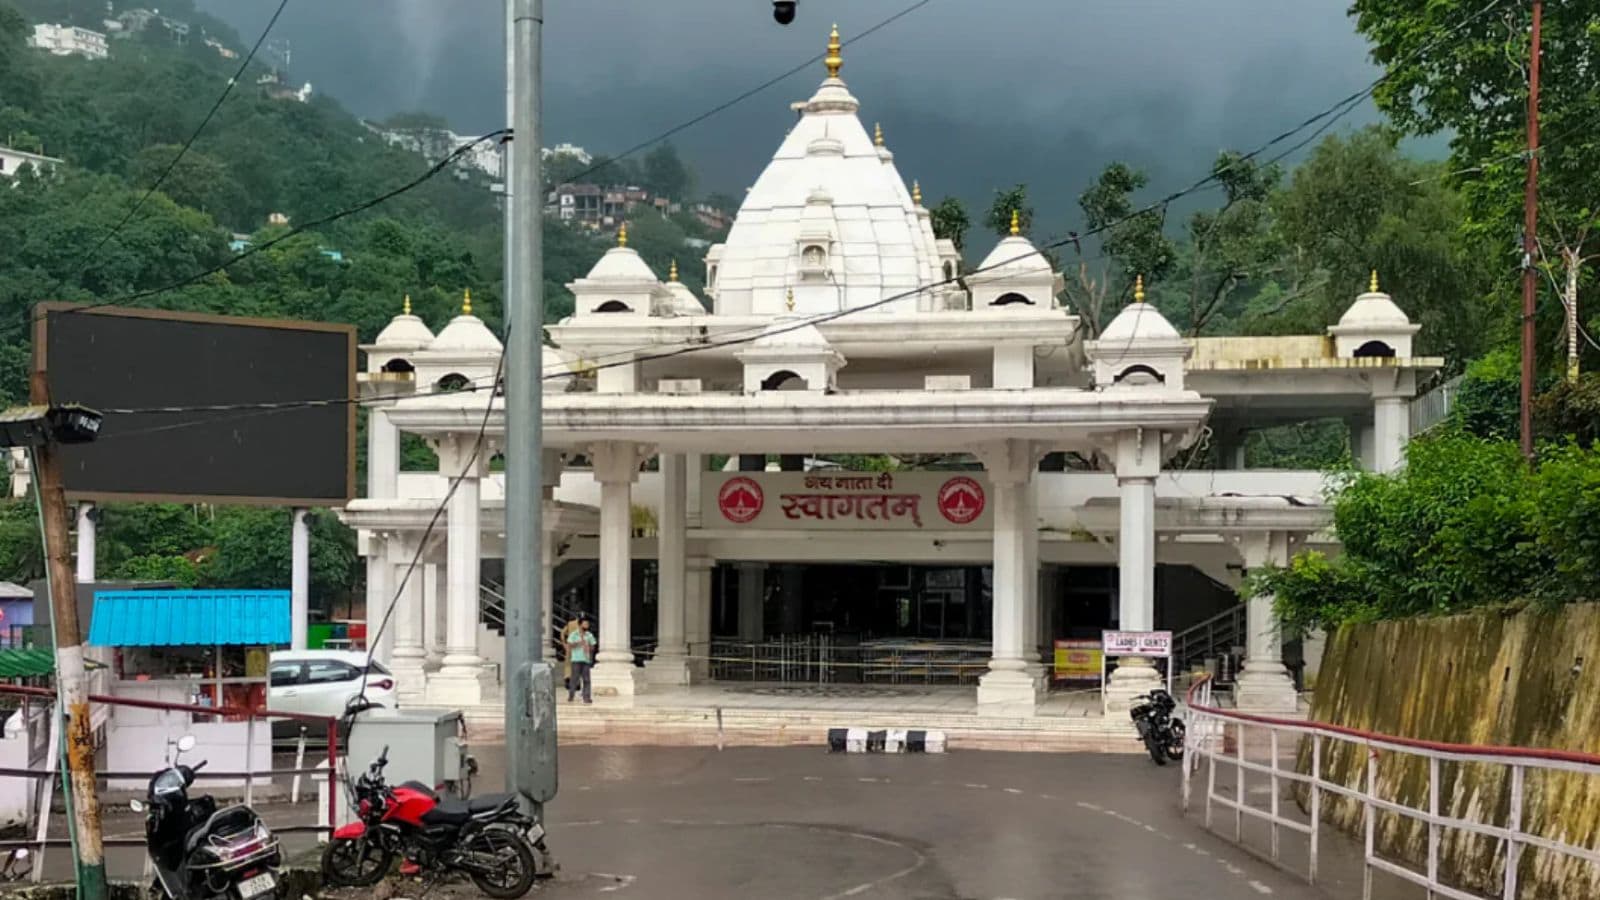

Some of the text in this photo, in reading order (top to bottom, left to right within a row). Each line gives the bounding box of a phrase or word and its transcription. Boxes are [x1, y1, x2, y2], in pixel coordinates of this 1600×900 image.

[804, 472, 893, 489] जय माता दी
[780, 493, 922, 527] स्वागतम्
[1144, 638, 1168, 647] GENTS
